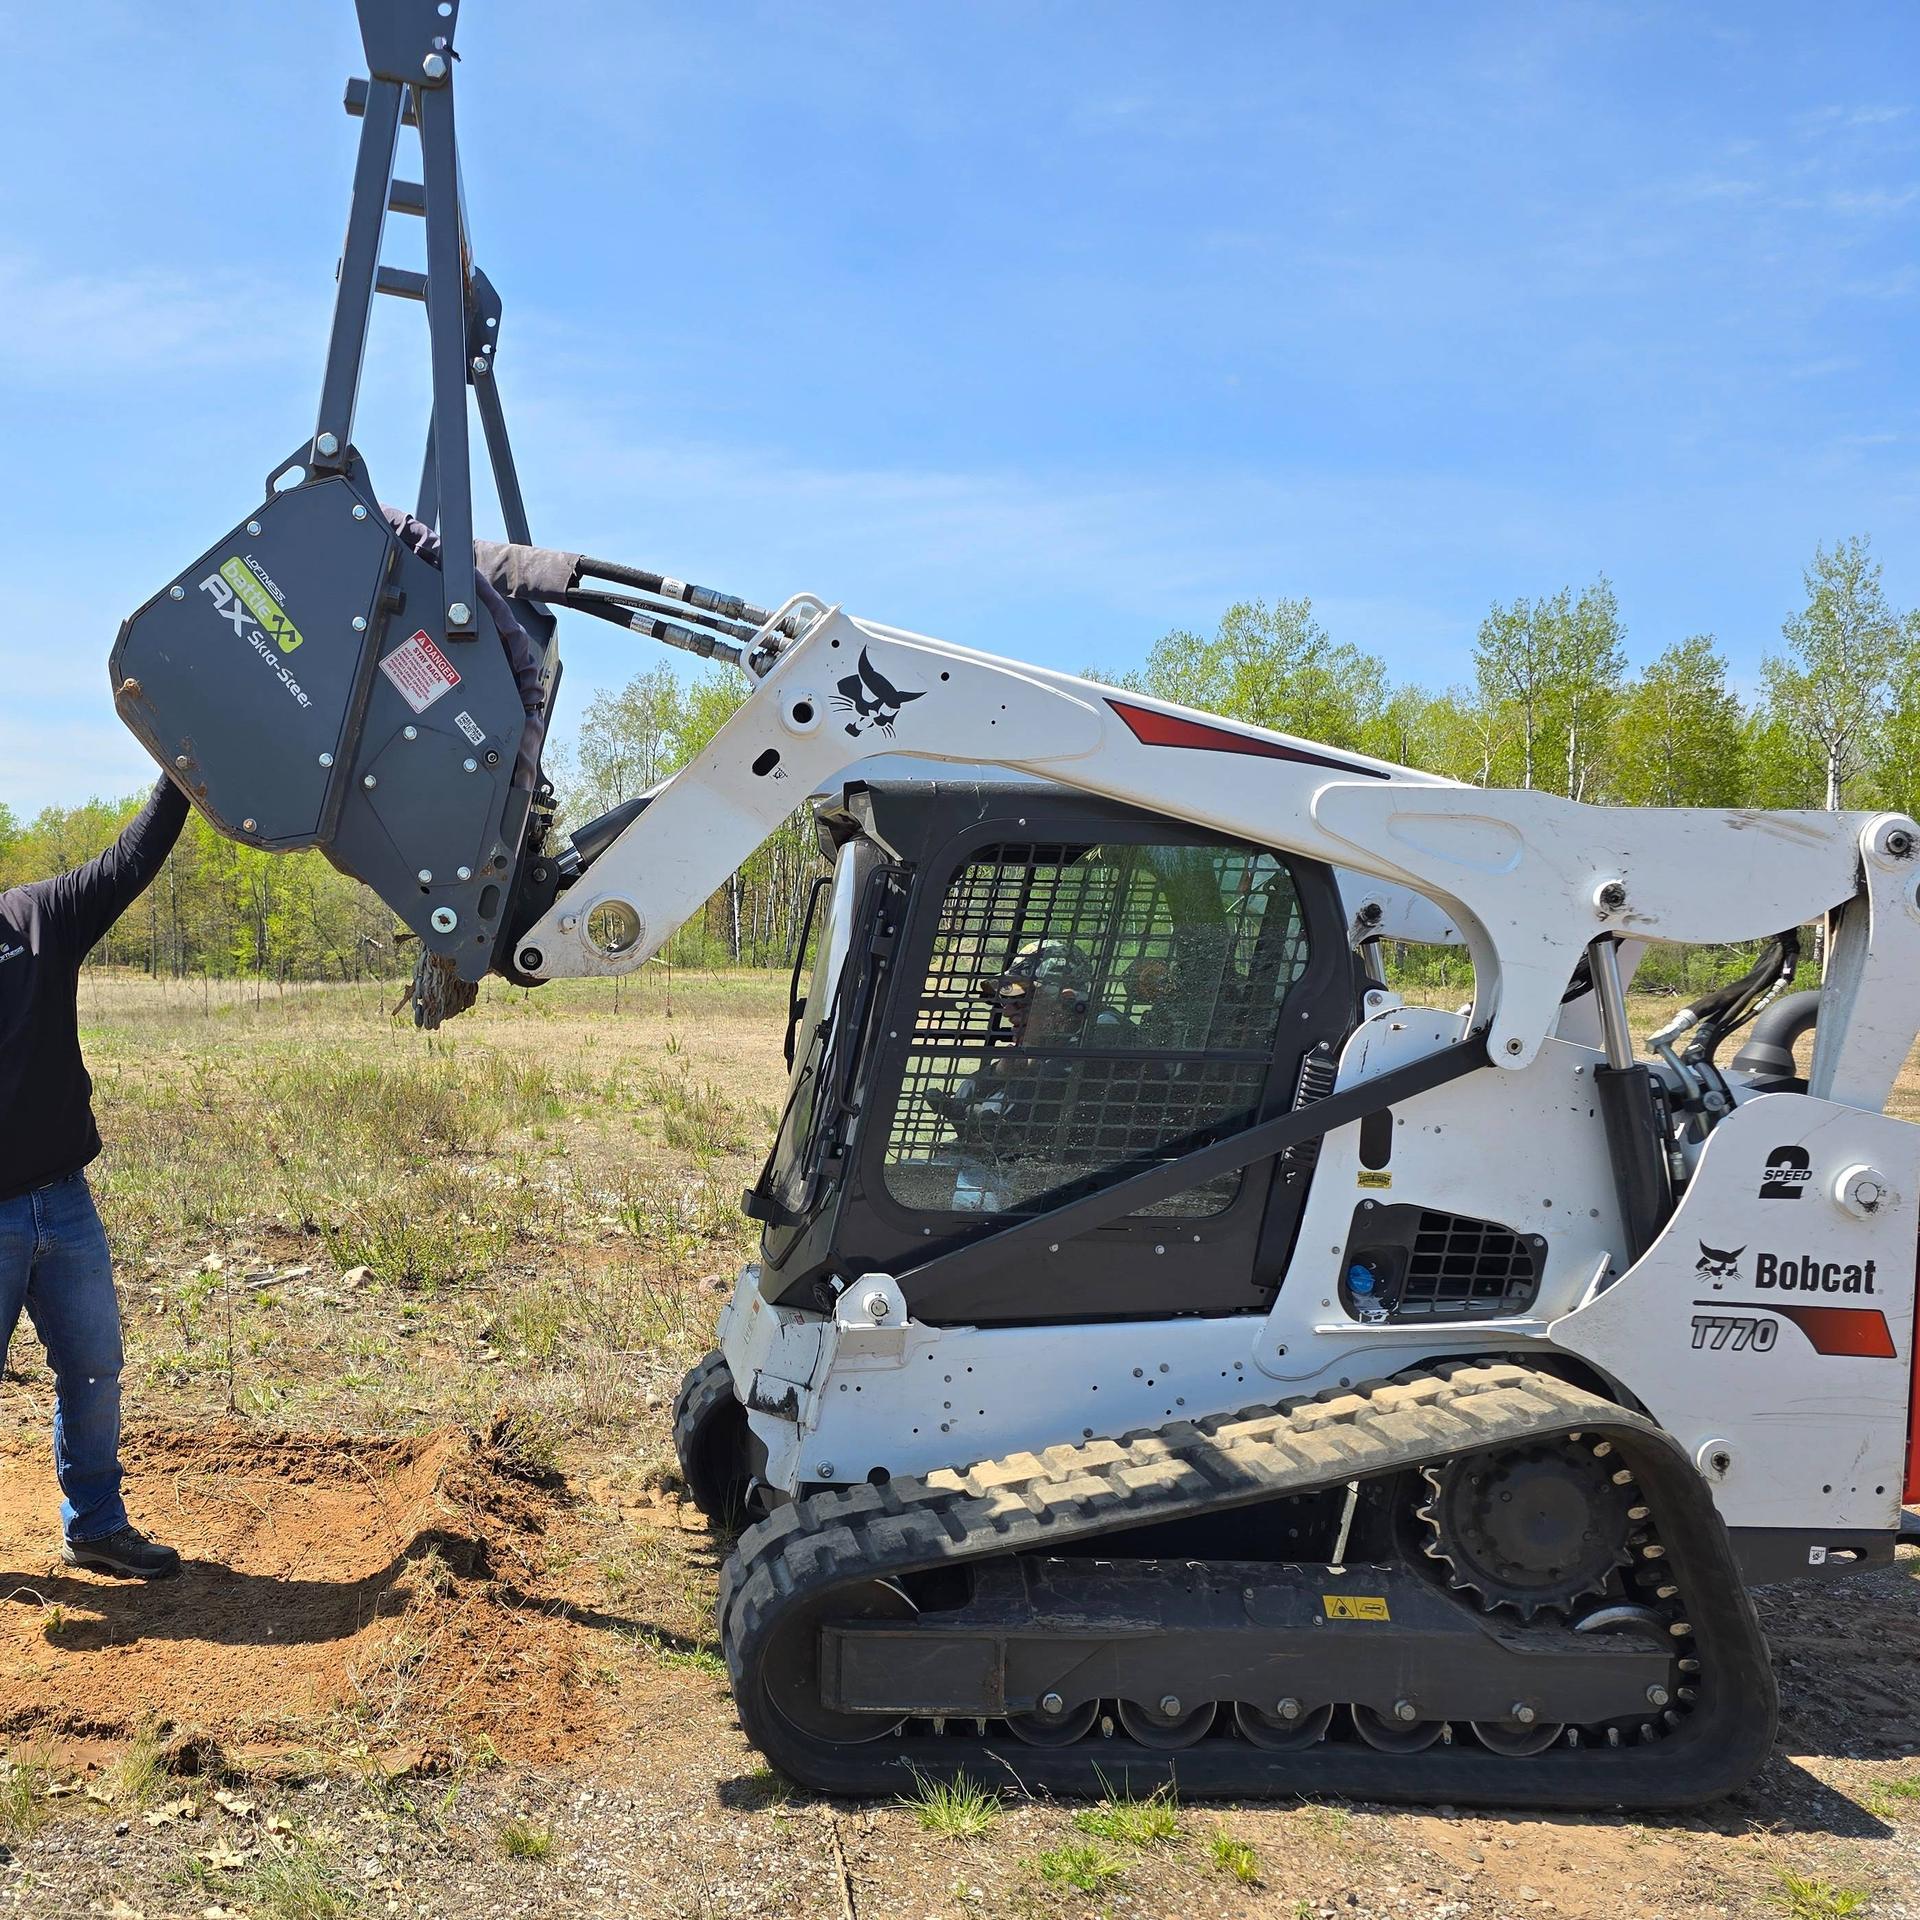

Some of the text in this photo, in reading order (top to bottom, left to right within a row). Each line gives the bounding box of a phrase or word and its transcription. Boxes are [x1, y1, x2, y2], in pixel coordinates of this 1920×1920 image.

[222, 560, 275, 619] battle
[244, 553, 285, 602] LOFTNESS
[197, 571, 312, 710] AX Skid-Steer
[412, 646, 443, 683] STAY BACK
[424, 643, 455, 681] DANGER
[1759, 1145, 1811, 1199] 2
[1763, 1170, 1812, 1181] SPEED
[1755, 1253, 1876, 1294] Bobcat
[1691, 1315, 1779, 1352] T770
